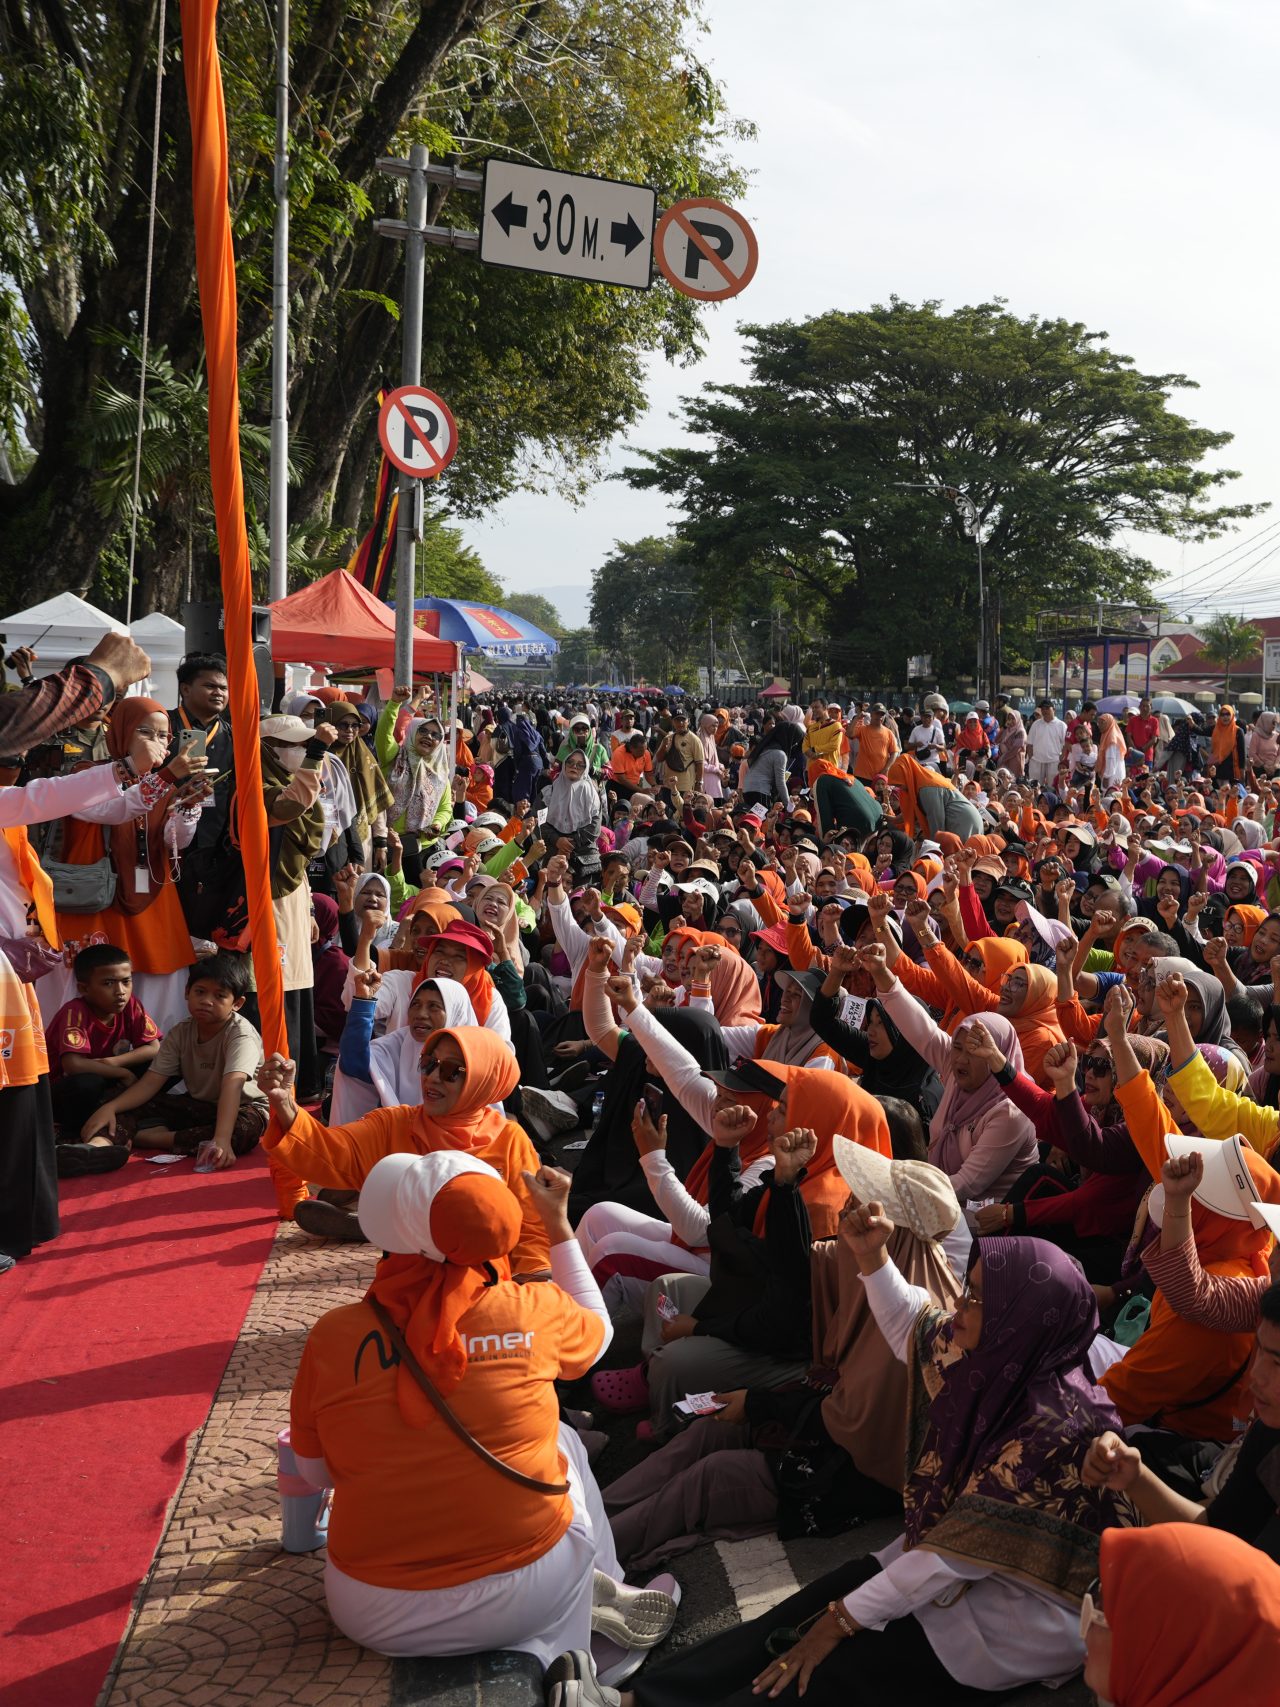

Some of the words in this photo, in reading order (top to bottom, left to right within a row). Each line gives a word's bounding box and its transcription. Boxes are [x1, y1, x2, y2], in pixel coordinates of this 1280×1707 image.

[533, 189, 576, 255] 30
[582, 214, 604, 261] M.
[685, 220, 734, 280] P
[403, 404, 439, 459] P
